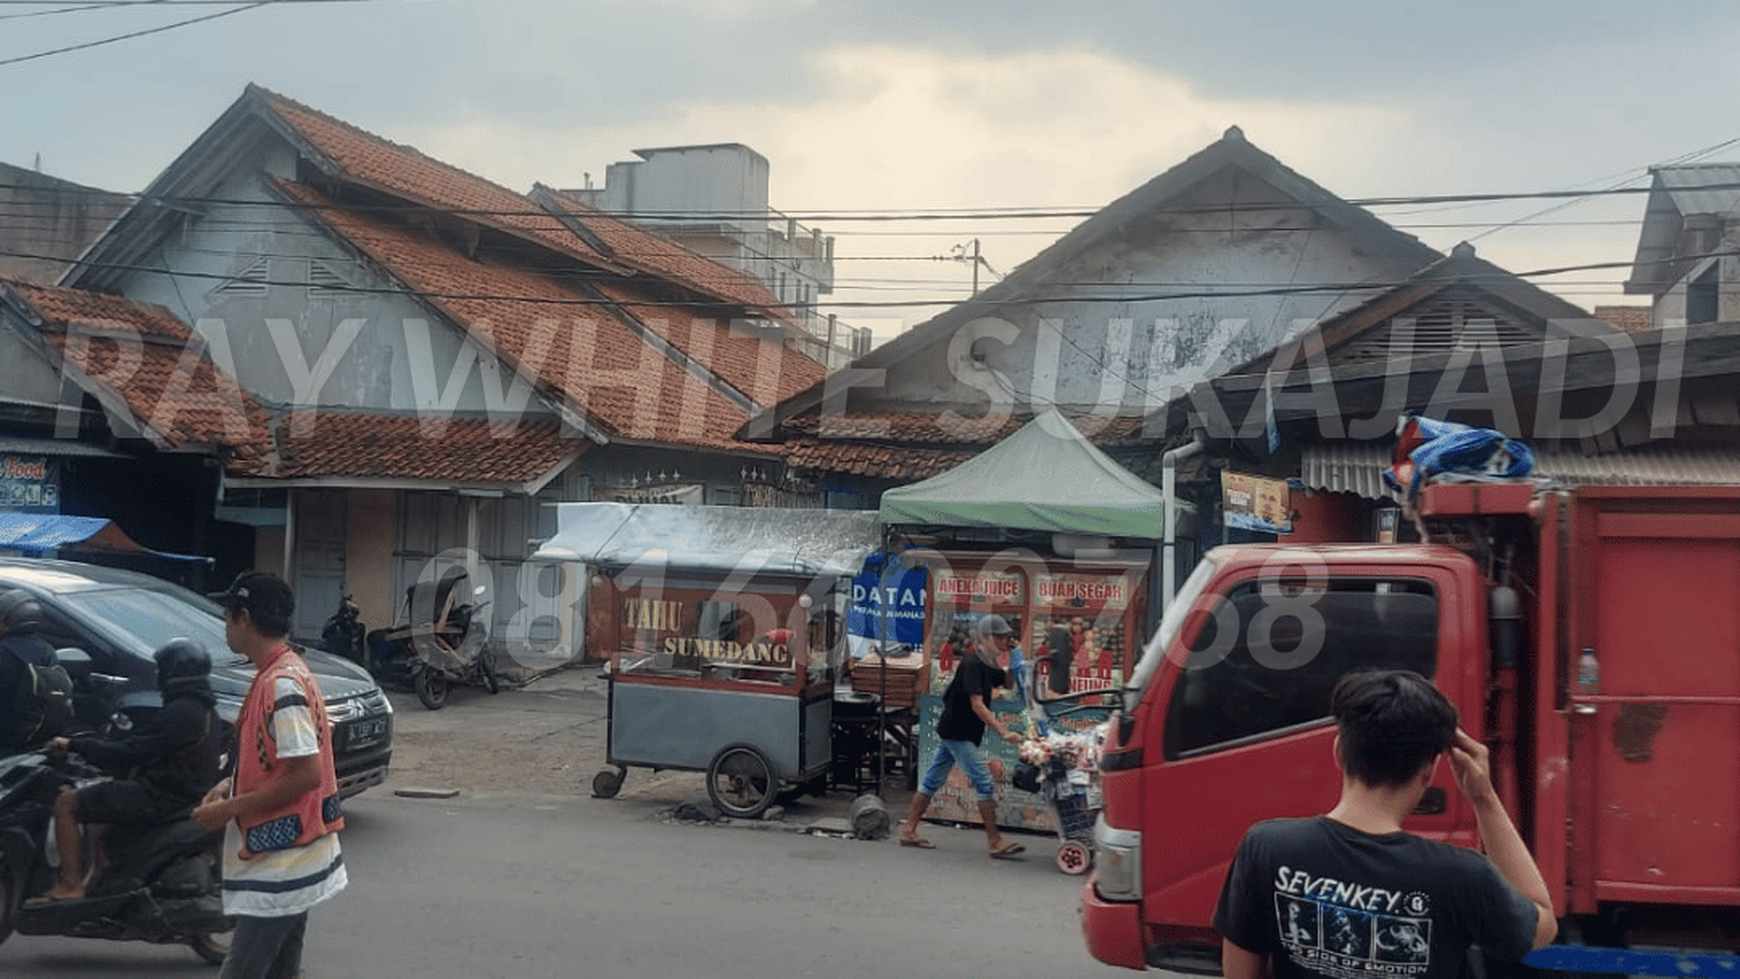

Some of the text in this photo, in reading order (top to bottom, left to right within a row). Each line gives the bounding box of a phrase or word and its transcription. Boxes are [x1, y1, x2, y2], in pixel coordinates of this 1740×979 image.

[5, 457, 47, 479] Food
[938, 577, 1019, 596] ANEKA JUICE
[1038, 581, 1122, 600] BUAH SEGAR
[624, 598, 683, 631] TAHU
[663, 636, 788, 663] SUMEDANG
[1307, 949, 1338, 963] SIDE
[1341, 957, 1361, 967] OF
[1364, 961, 1428, 974] EMOTION
